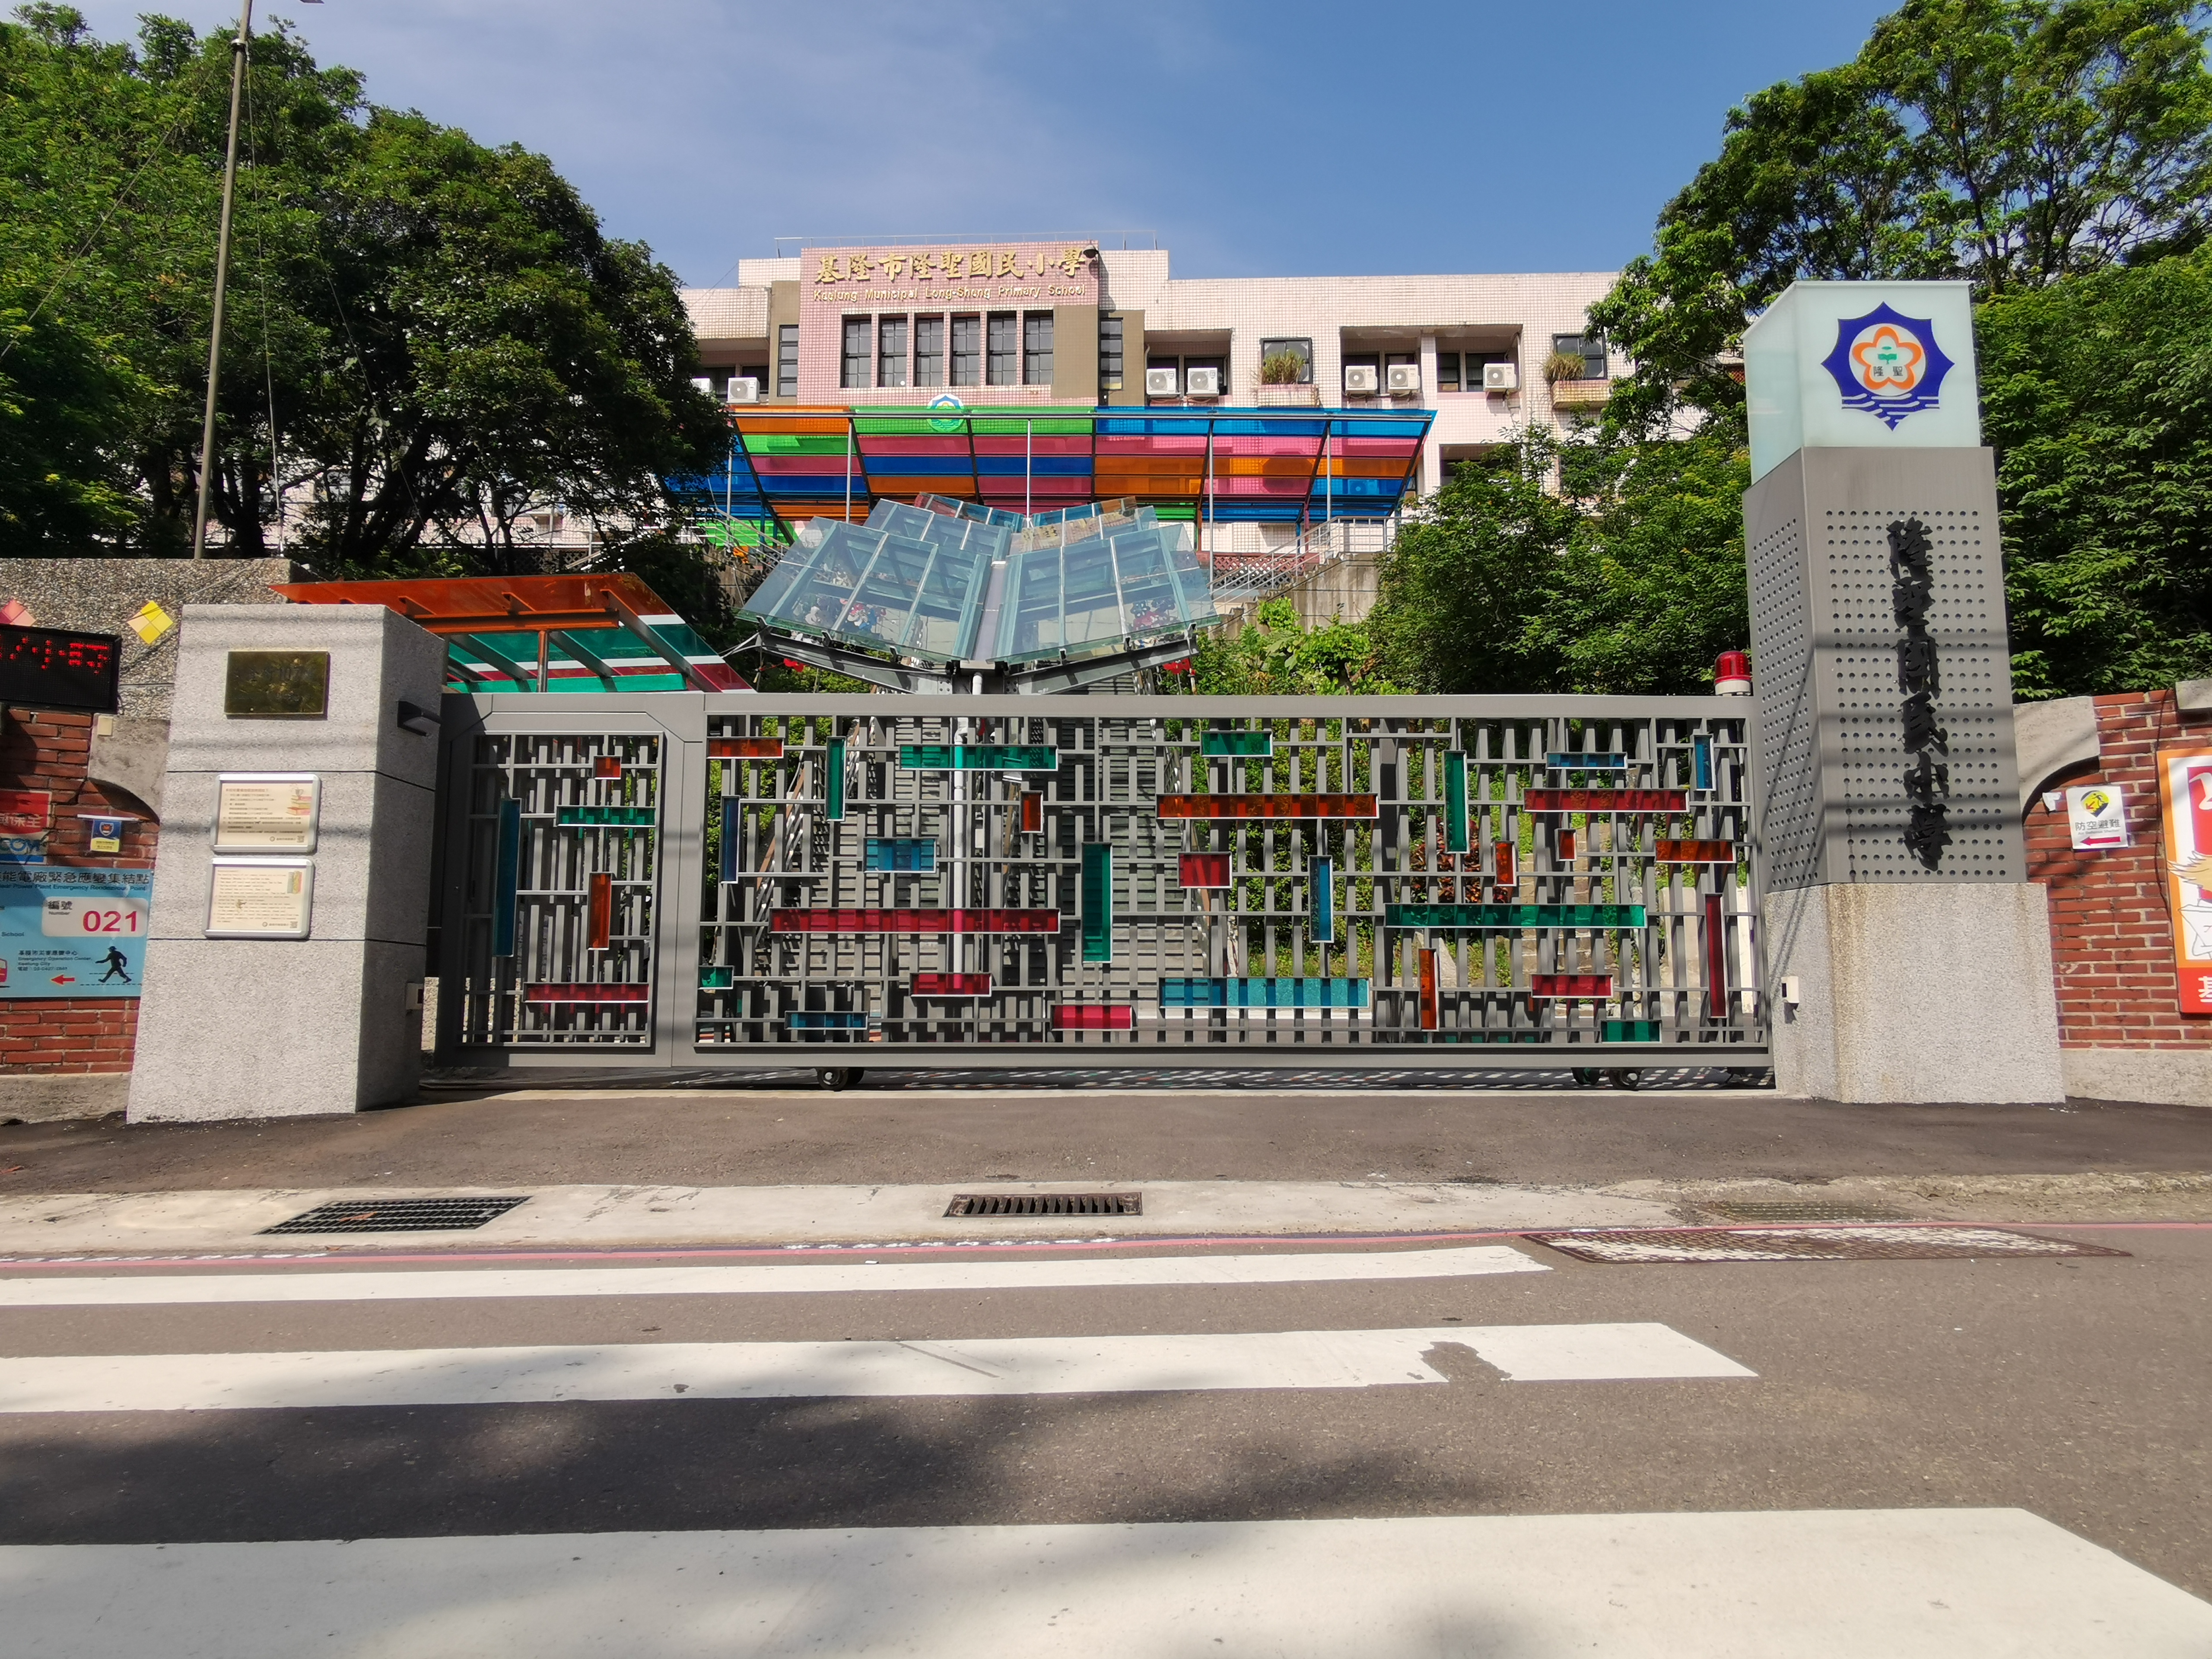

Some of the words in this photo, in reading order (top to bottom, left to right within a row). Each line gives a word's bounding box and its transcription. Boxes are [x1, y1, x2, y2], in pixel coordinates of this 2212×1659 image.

[815, 247, 1086, 283] 基隆市隆聖國民小學
[814, 289, 858, 302] Keelung
[865, 287, 918, 302] Municipal
[925, 286, 991, 299] Long-Sheng
[998, 284, 1041, 298] Primary
[1048, 283, 1085, 296] School
[2075, 819, 2121, 831] 防空避難
[0, 871, 149, 884] 能電廠緊急應變集結點
[83, 910, 137, 932] 021
